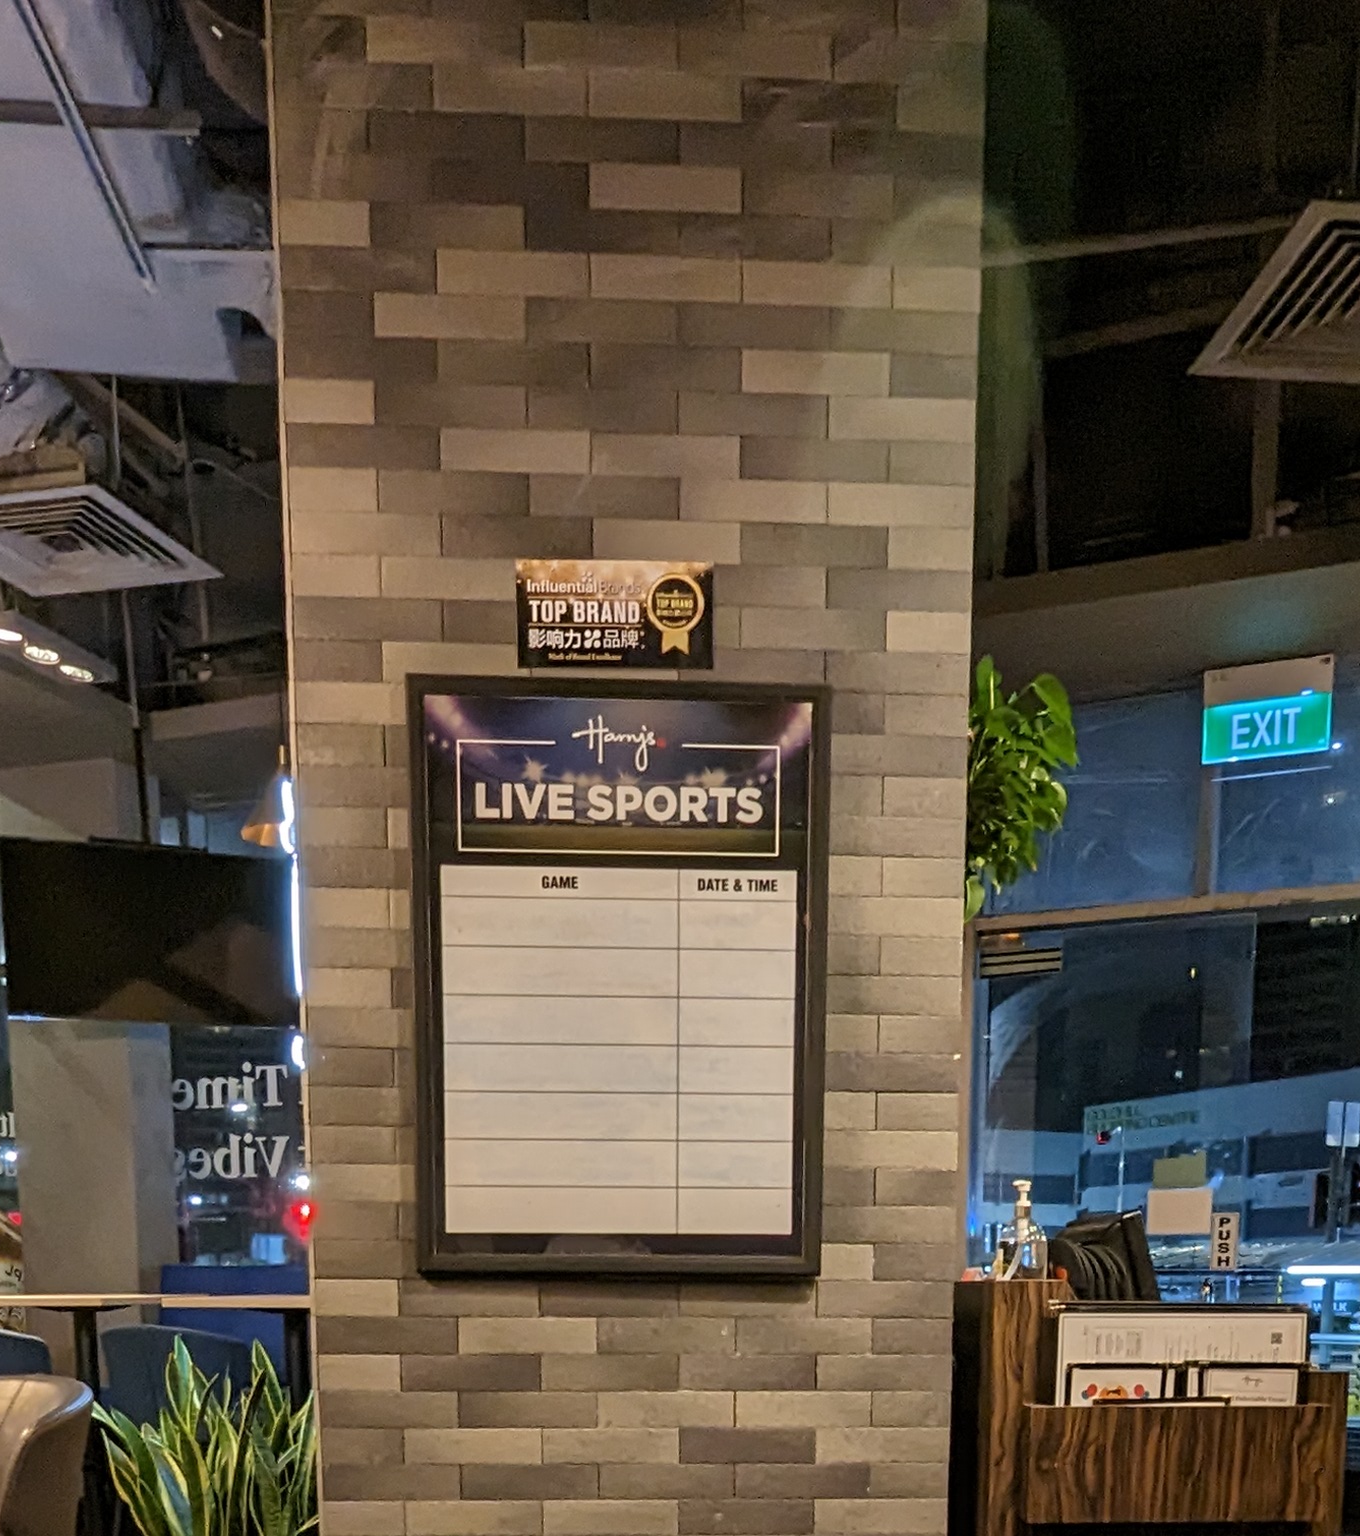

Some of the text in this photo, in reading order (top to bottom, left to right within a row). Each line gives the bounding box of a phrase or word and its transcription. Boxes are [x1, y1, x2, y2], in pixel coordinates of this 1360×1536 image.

[527, 578, 597, 594] Influential
[529, 600, 640, 624] TOP BRAND
[1231, 707, 1302, 750] EXIT
[571, 714, 657, 772] Harry's
[474, 782, 764, 825] LIVE SPORTS
[541, 876, 579, 890] GAME
[697, 878, 778, 893] DATE & TIME
[1217, 1216, 1231, 1267] PUSH
[1306, 1301, 1348, 1312] WLK
